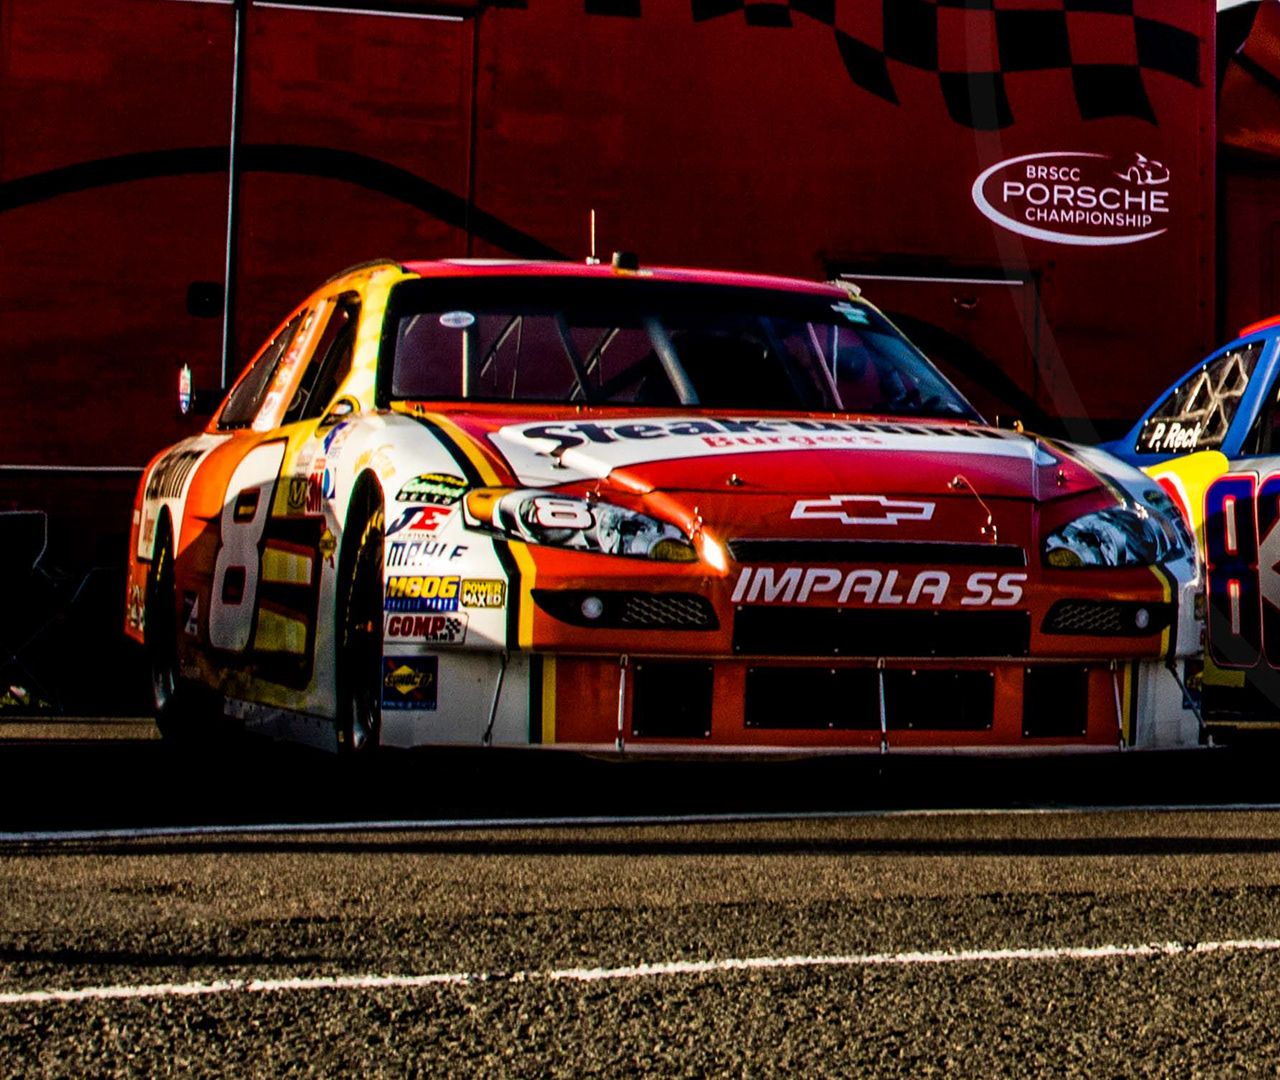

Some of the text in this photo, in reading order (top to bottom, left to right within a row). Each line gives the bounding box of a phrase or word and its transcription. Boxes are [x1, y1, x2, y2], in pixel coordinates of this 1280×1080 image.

[1026, 164, 1080, 182] BRSCC
[1003, 182, 1169, 213] PORSCHE
[1025, 207, 1152, 228] CHAMPIONSHIP
[701, 434, 884, 448] Burgers
[385, 506, 452, 537] JE
[533, 497, 595, 530] 8
[209, 436, 288, 652] 8
[463, 582, 501, 594] POWER
[731, 567, 1028, 606] IMPALA SS
[463, 593, 502, 607] MAXED
[388, 616, 445, 637] COMP
